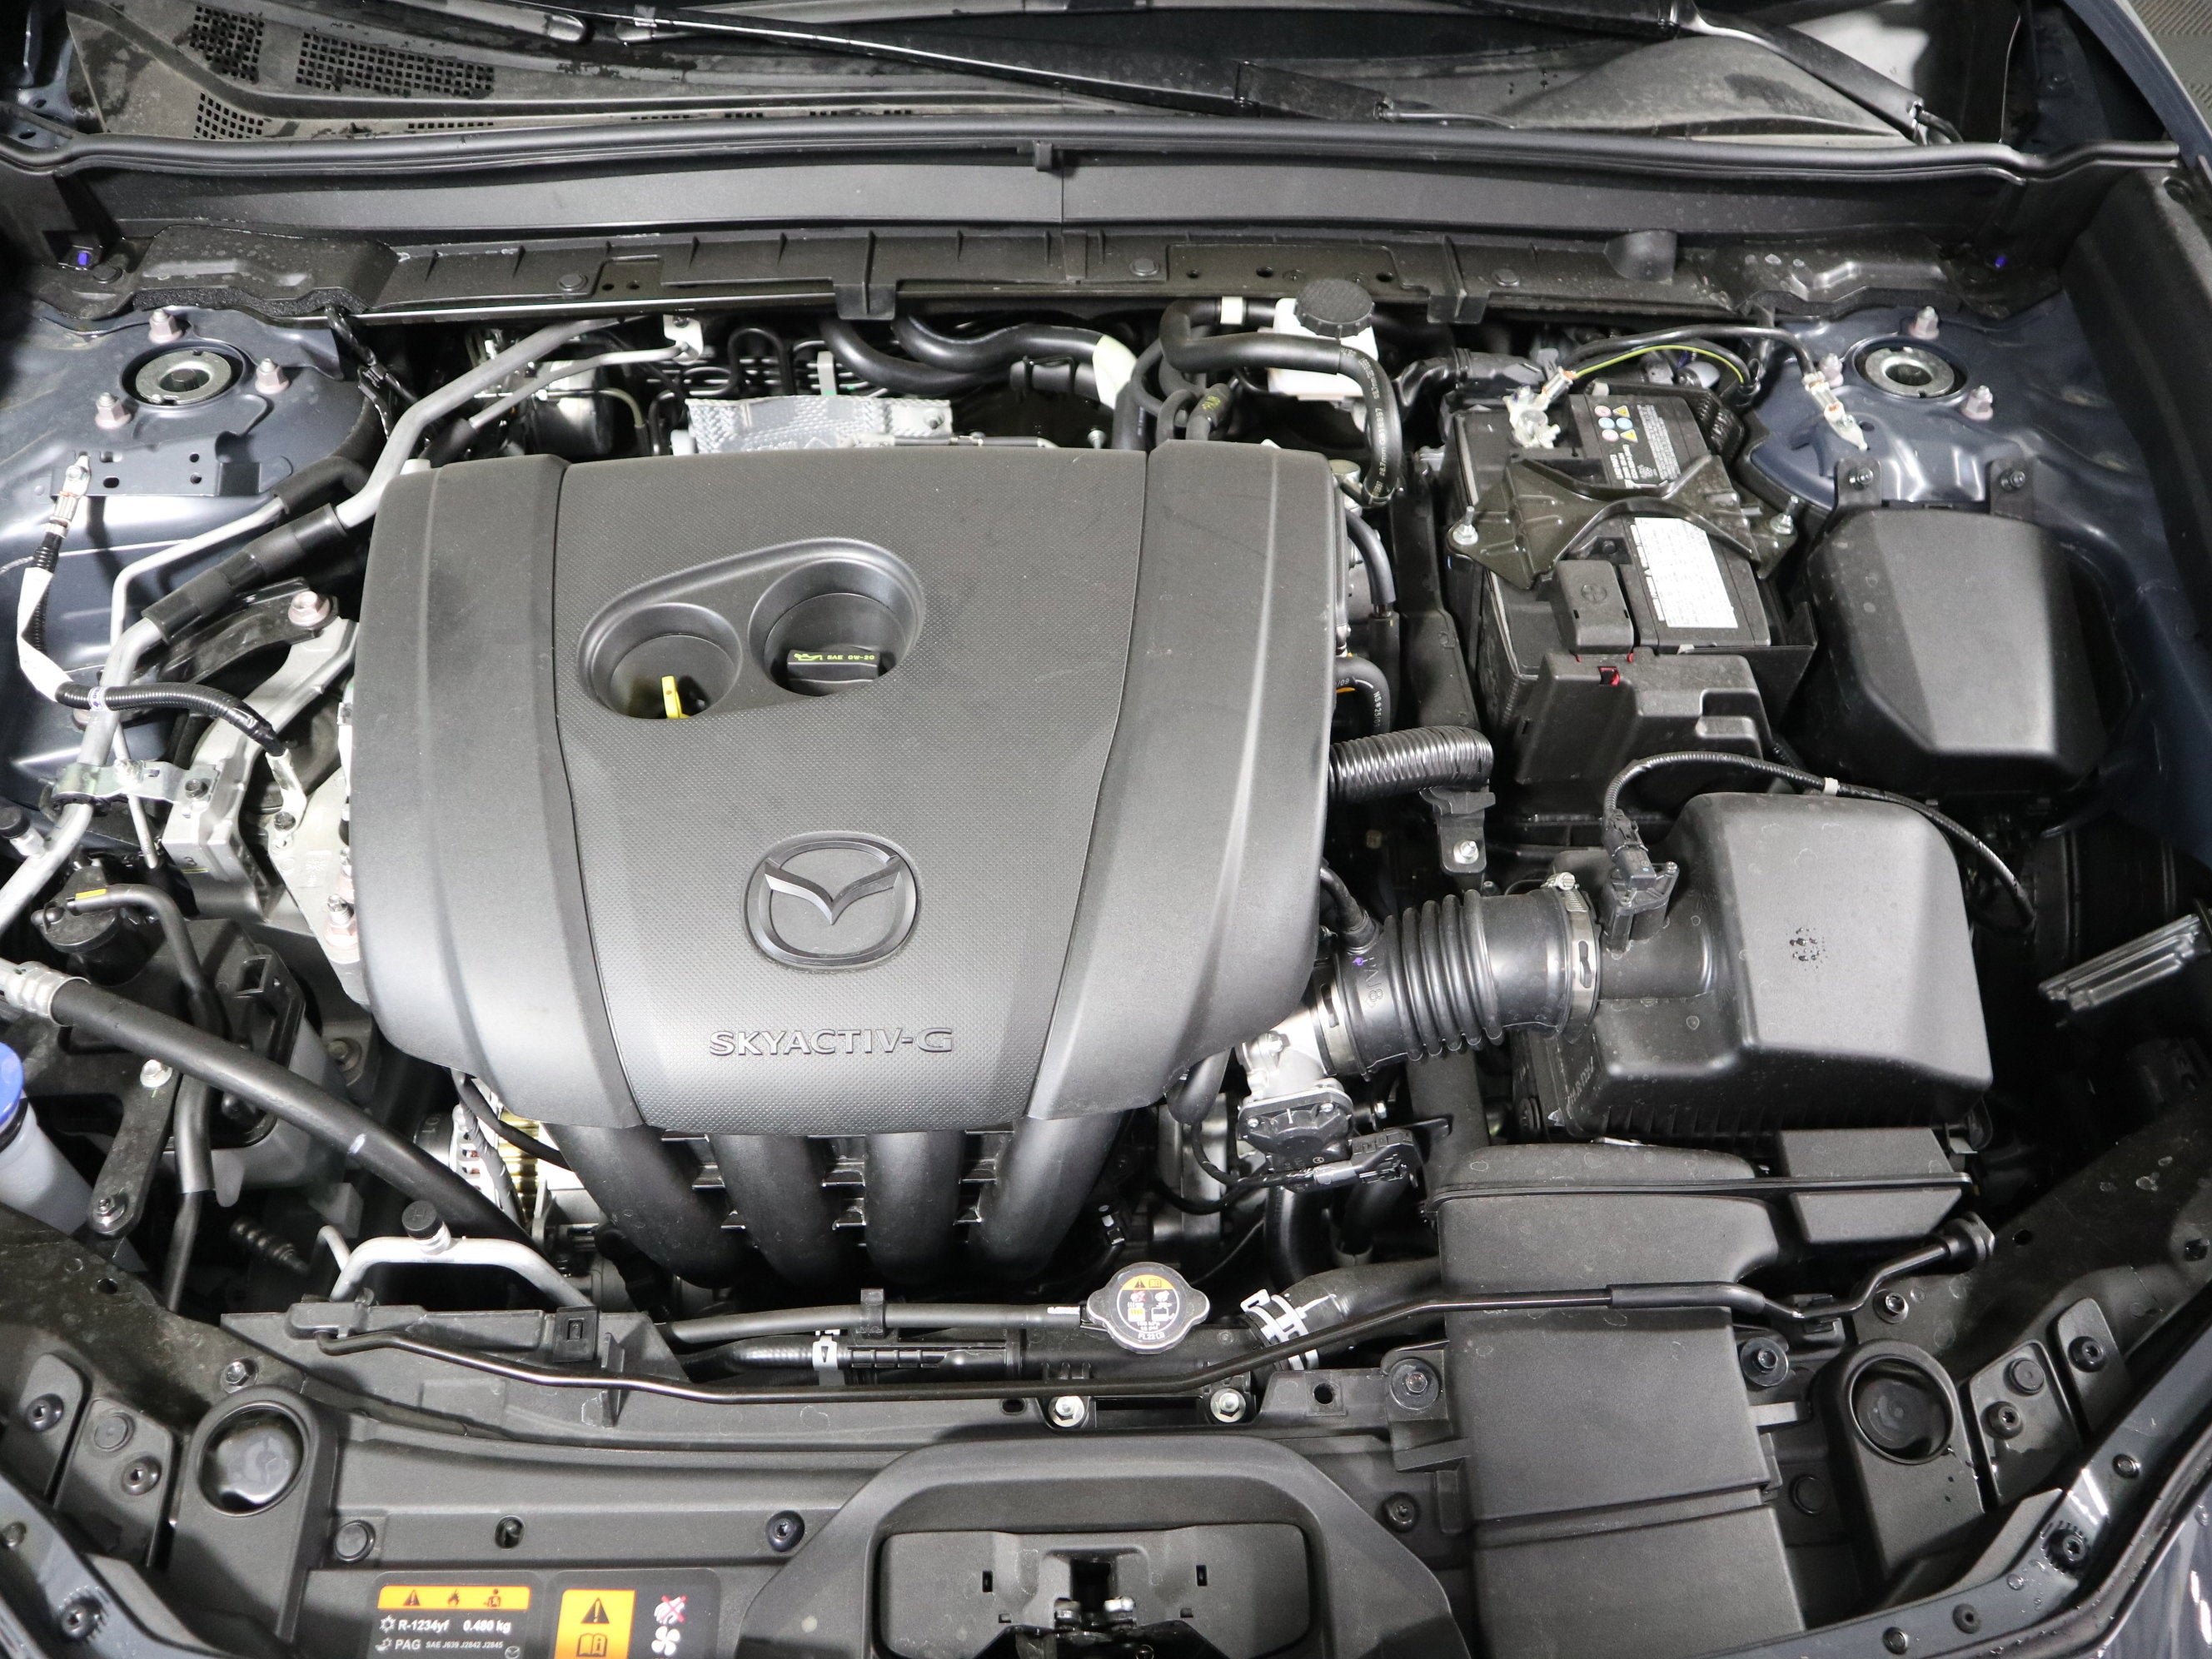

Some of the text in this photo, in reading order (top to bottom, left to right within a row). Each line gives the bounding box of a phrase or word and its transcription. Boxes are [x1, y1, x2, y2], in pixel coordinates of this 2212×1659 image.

[709, 1027, 954, 1057] SKYACTIV-G
[397, 1619, 451, 1633] R-1234yf
[496, 1620, 512, 1635] kg
[394, 1638, 421, 1651] PAG
